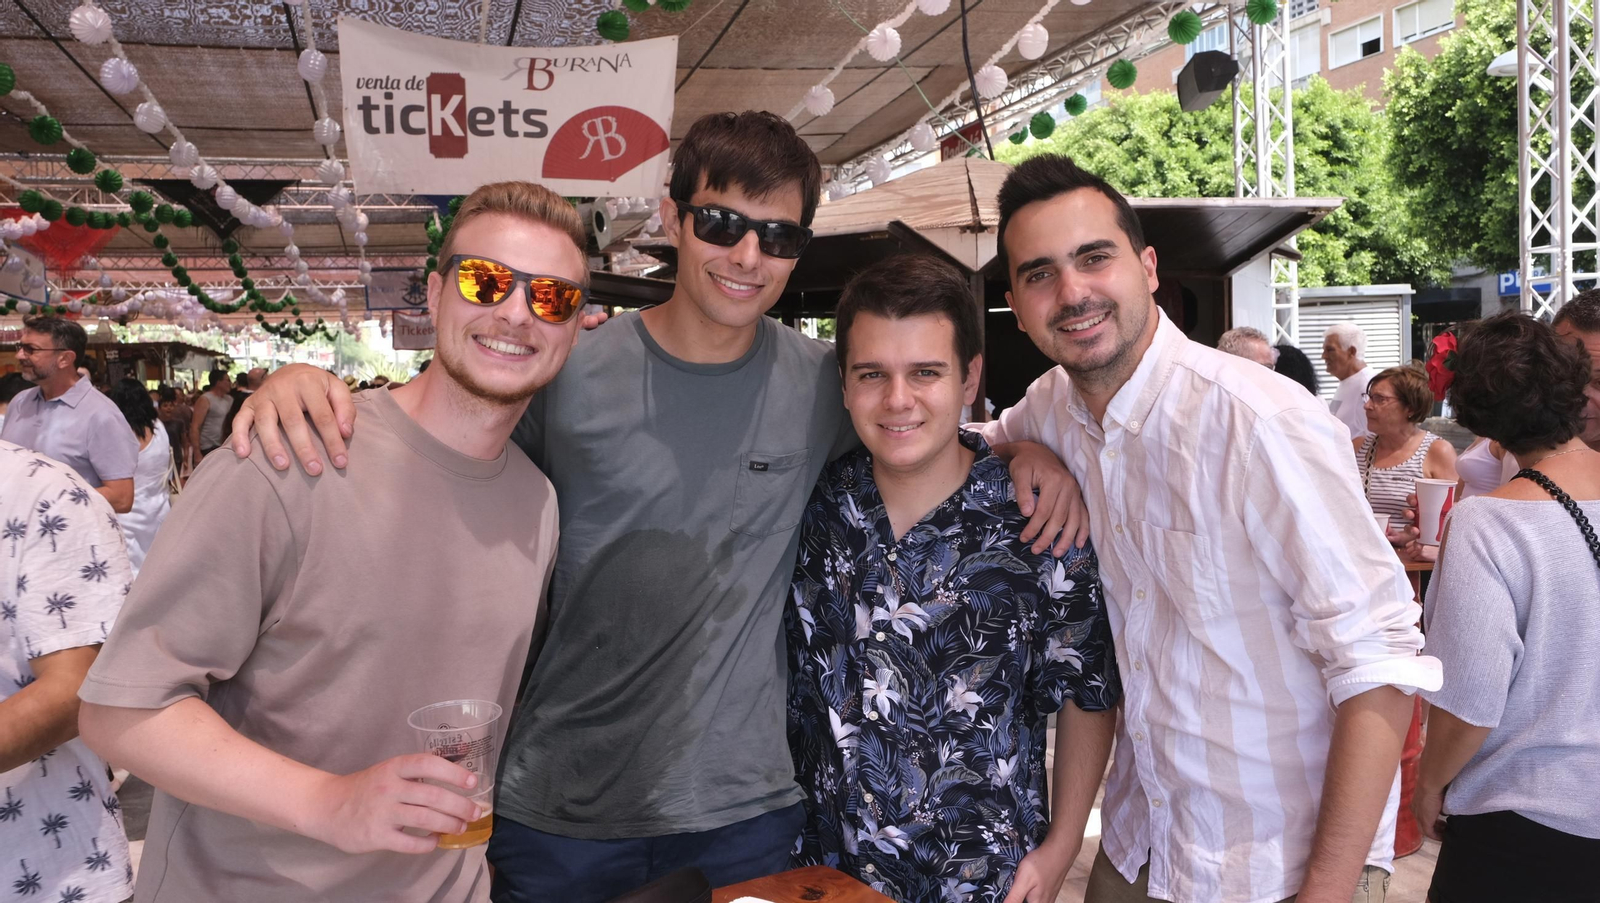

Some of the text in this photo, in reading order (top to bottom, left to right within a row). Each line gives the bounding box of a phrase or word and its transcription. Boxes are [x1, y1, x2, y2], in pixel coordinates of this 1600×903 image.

[356, 75, 425, 91] venta de
[401, 324, 435, 336] Tickets
